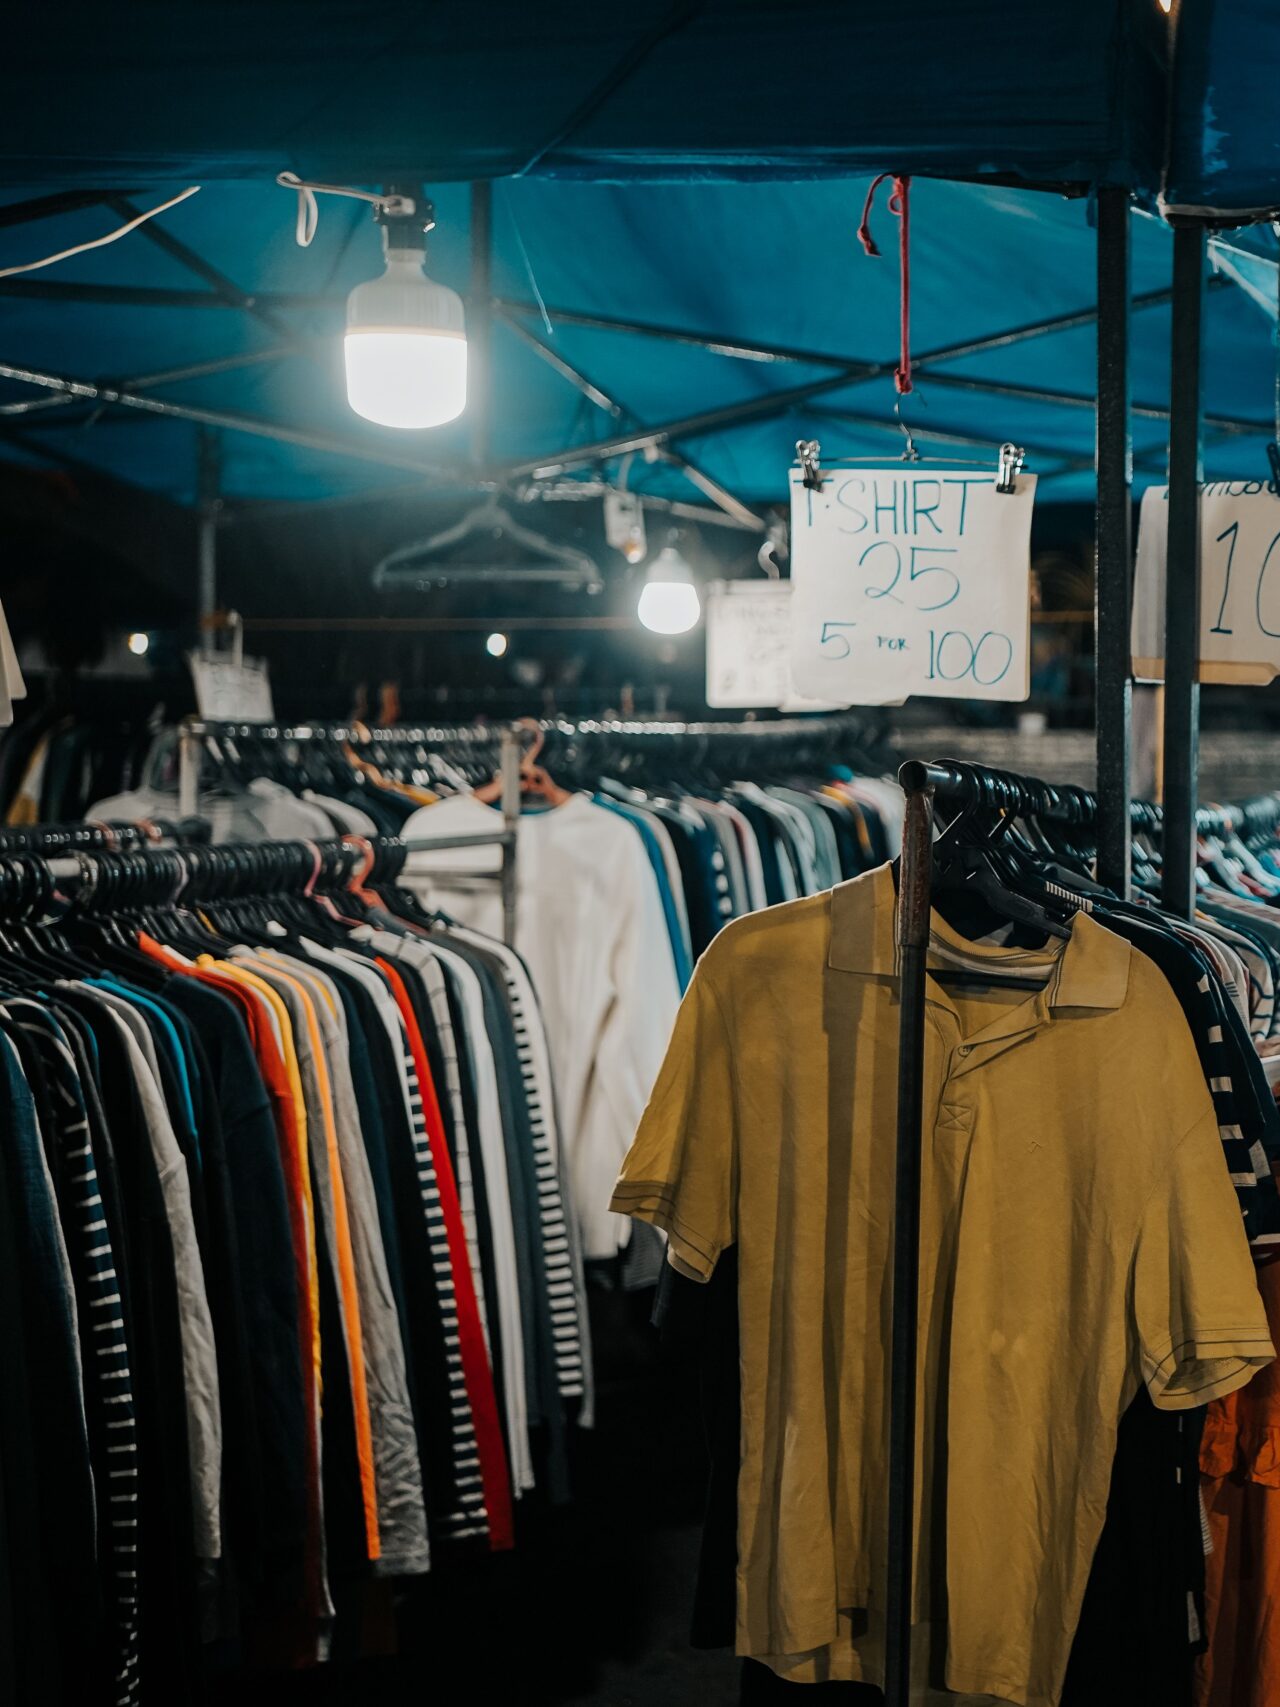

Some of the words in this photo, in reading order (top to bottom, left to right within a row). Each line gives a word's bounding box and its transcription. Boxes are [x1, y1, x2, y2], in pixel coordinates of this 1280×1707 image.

[859, 541, 959, 611] 25
[820, 622, 857, 660] 5
[876, 635, 910, 651] FOR
[925, 629, 1013, 685] 100
